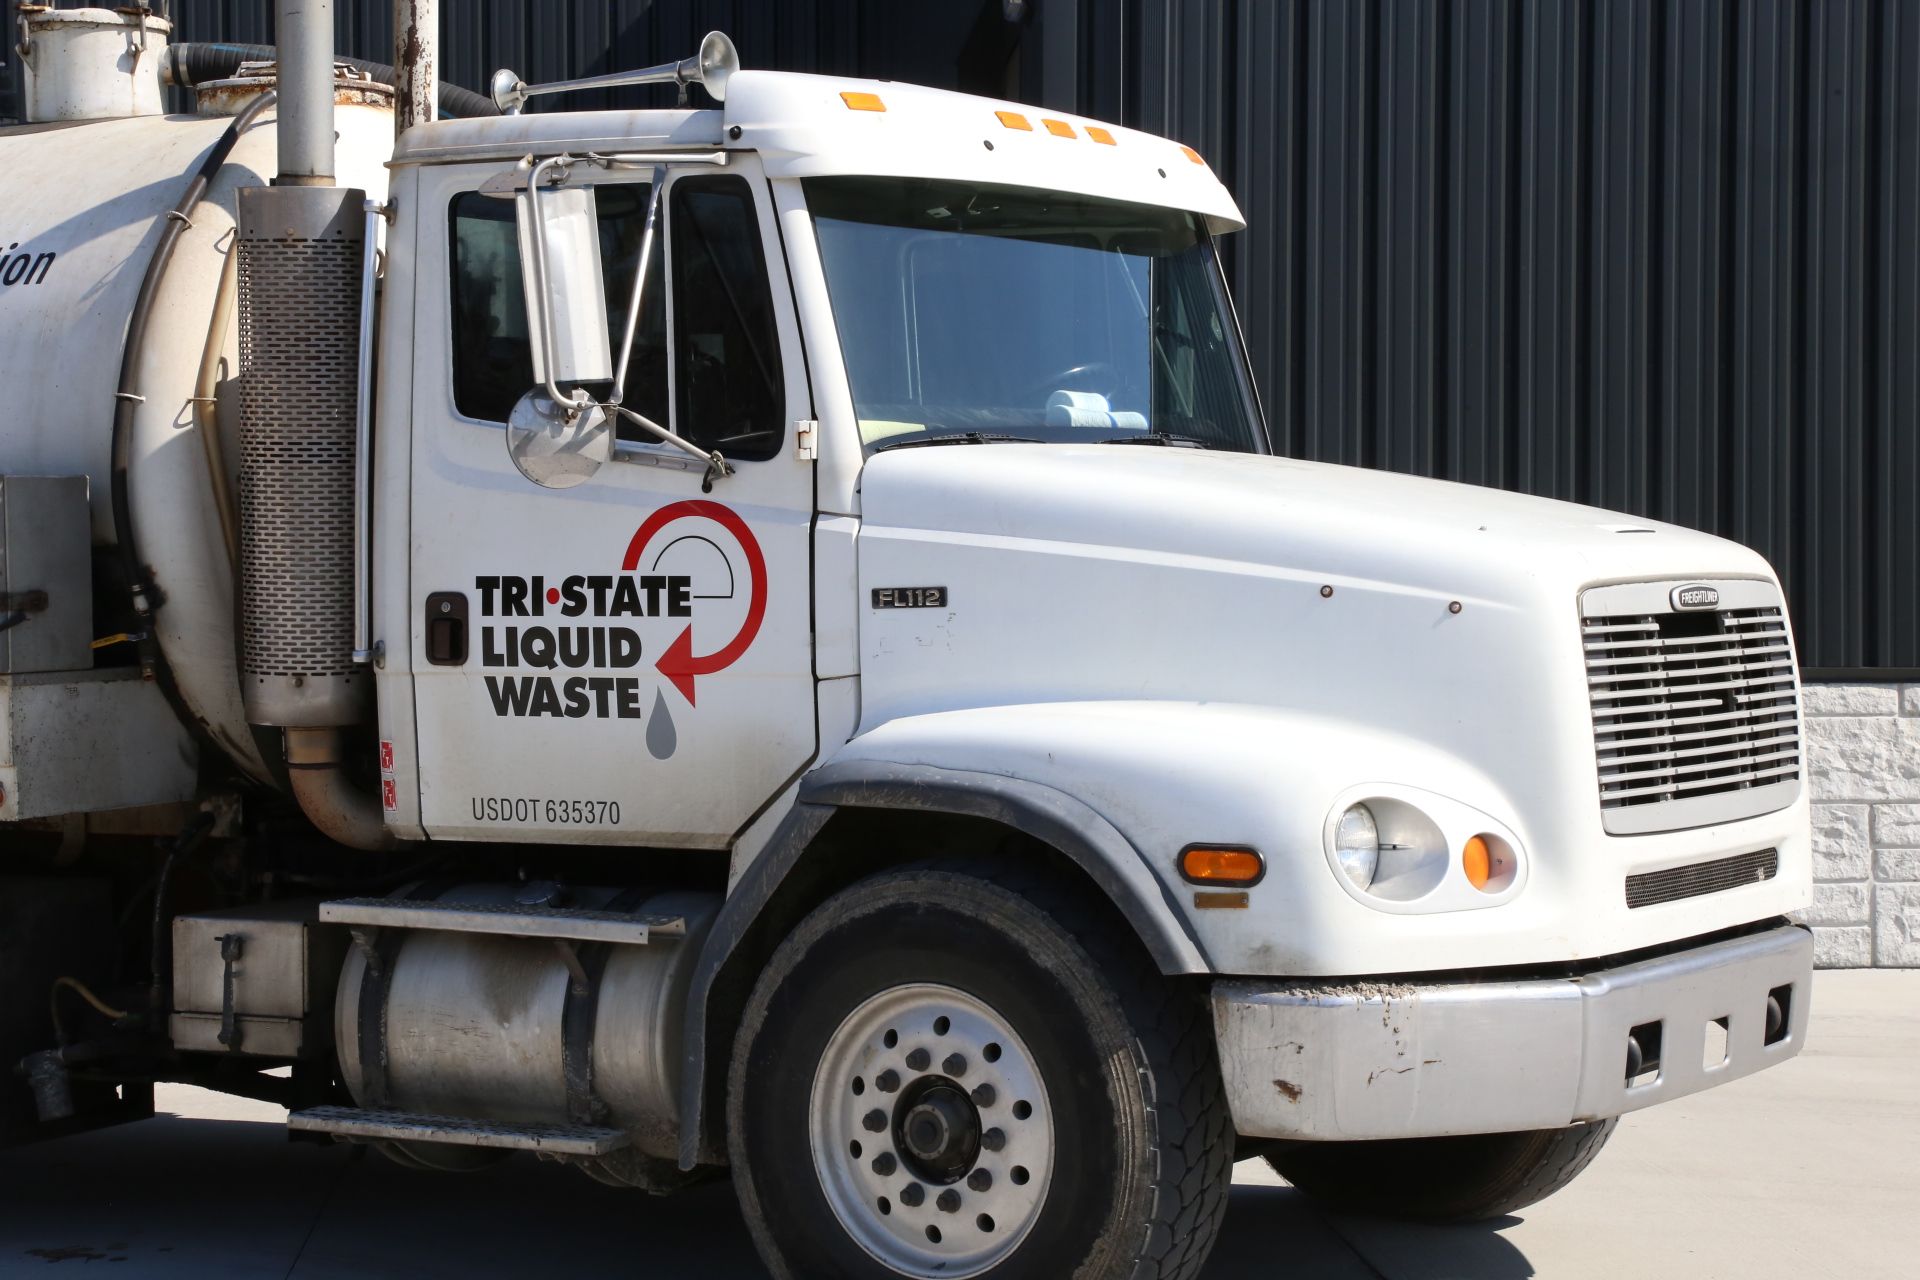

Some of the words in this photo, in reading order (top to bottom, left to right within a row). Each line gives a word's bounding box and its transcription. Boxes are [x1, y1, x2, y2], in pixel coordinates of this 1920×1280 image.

[0, 242, 56, 286] ion
[879, 589, 940, 606] FL112
[481, 626, 642, 670] LIQUID
[484, 675, 641, 719] WASTE
[472, 797, 541, 822] USDOT
[545, 799, 620, 825] 635370
